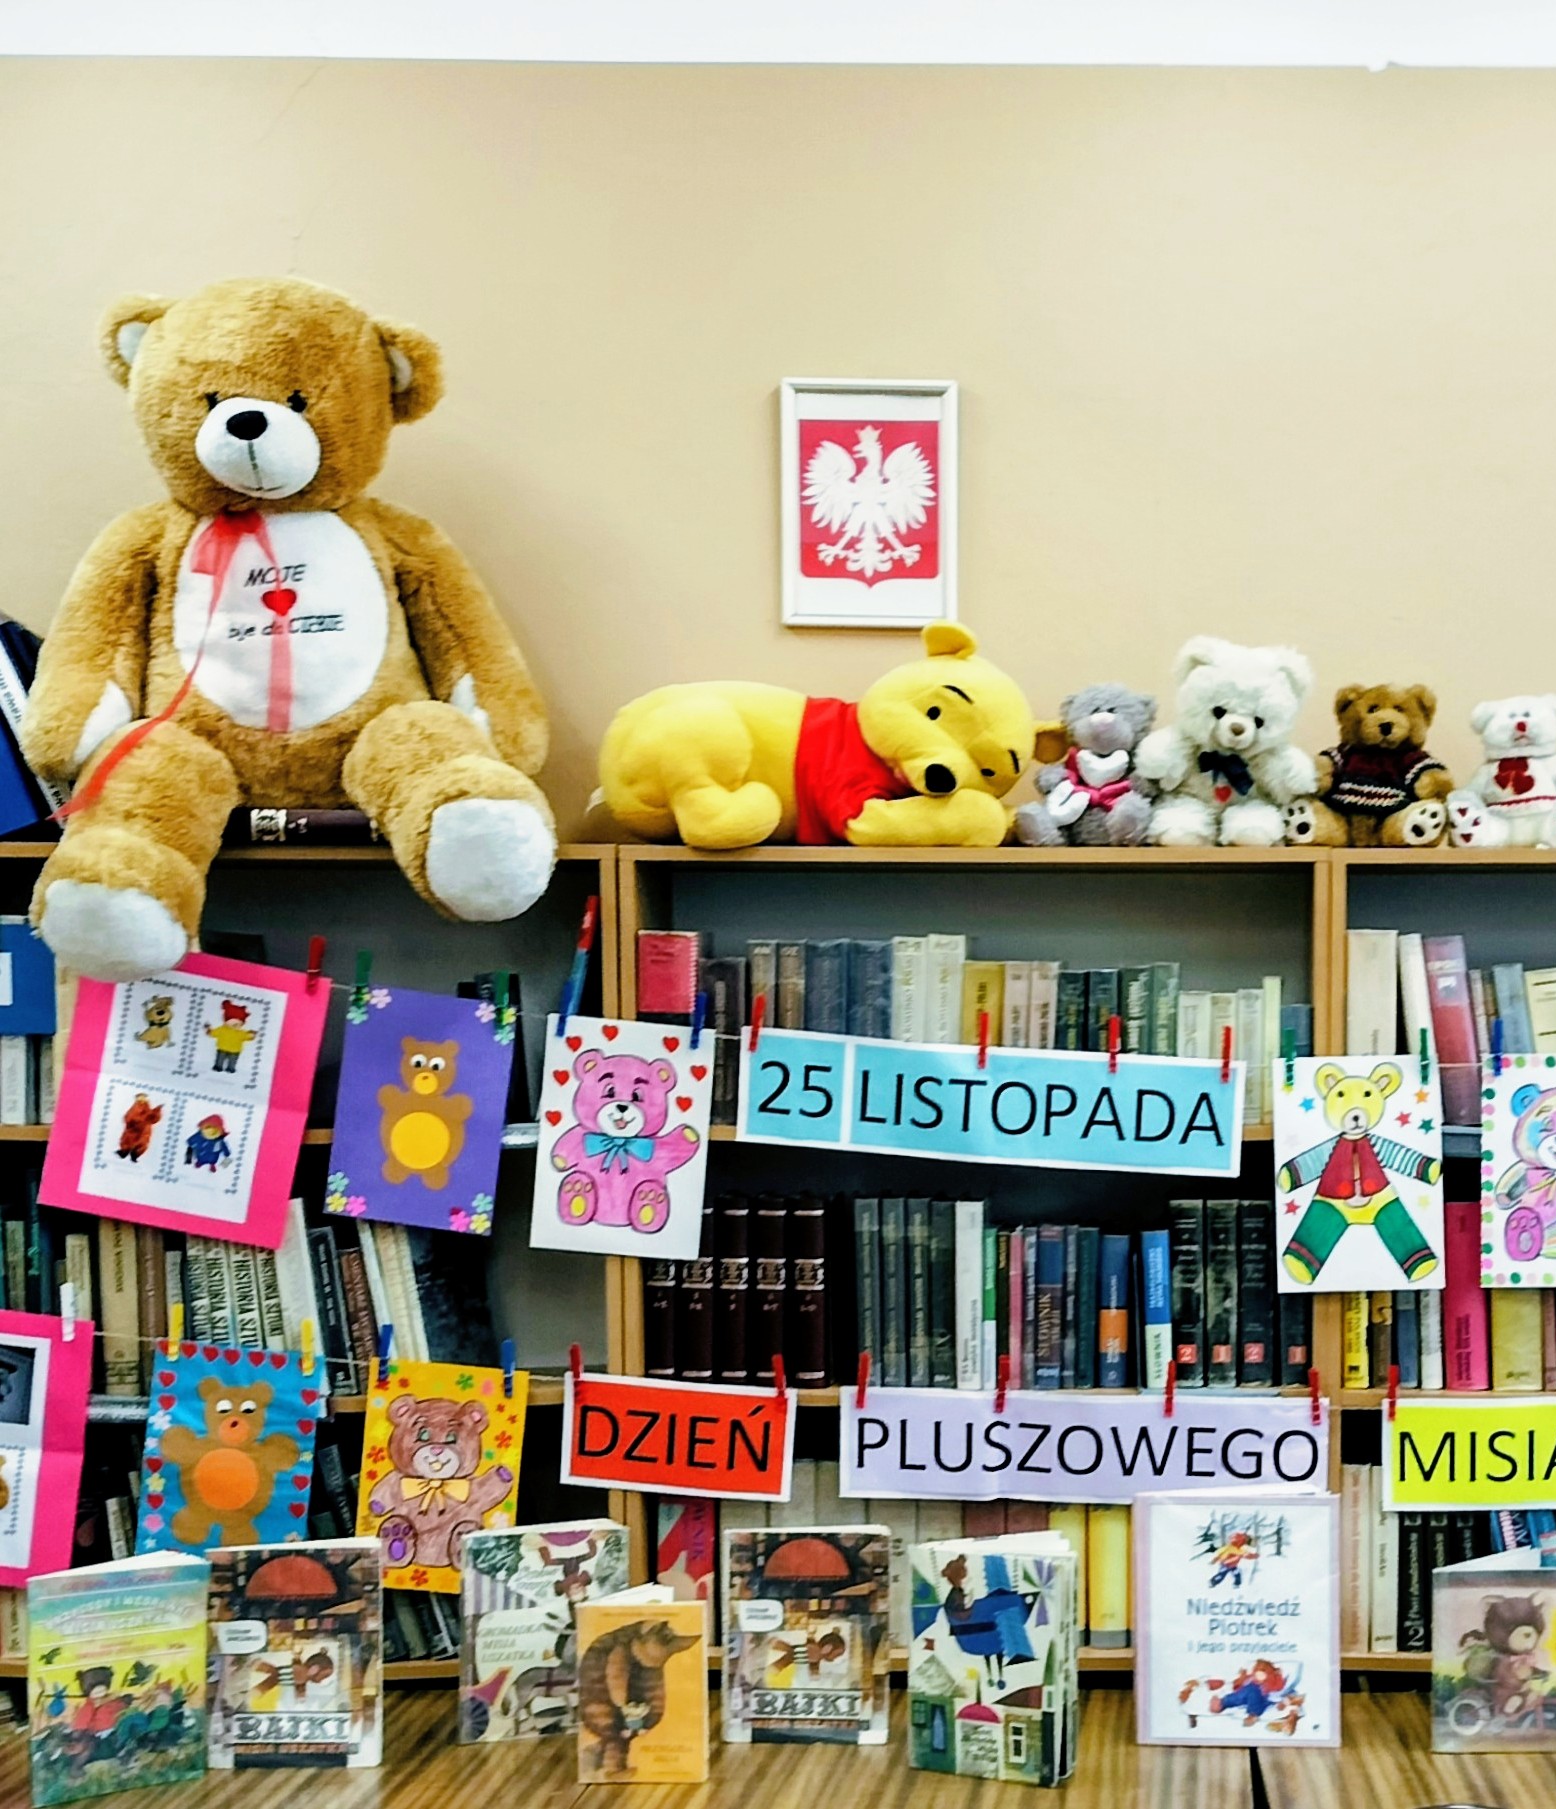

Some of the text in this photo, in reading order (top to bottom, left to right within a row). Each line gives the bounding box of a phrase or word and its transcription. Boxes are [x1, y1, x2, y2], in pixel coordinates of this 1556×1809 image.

[244, 563, 307, 588] MOJE
[758, 1060, 1224, 1147] 25 LISTOPADA
[206, 1257, 231, 1347] HISTORIA SZTU
[233, 1258, 259, 1349] HISTORIA SZTU
[259, 1256, 285, 1337] HISTORIA SZTUKI
[1037, 1293, 1052, 1358] SŁOWNIK
[1180, 1346, 1193, 1361] 2
[1246, 1345, 1260, 1361] 2
[578, 1405, 772, 1472] DZIEŃ
[857, 1417, 1319, 1482] PLUSZOWEGO
[1186, 1595, 1301, 1617] Niedźwiedź
[1208, 1618, 1279, 1636] Piotrek
[1407, 1626, 1425, 1646] 2
[1197, 1640, 1226, 1654] jego
[1229, 1640, 1299, 1654] przyjaciele
[753, 1692, 862, 1717] BAJKI
[235, 1715, 350, 1741] BAJKI
